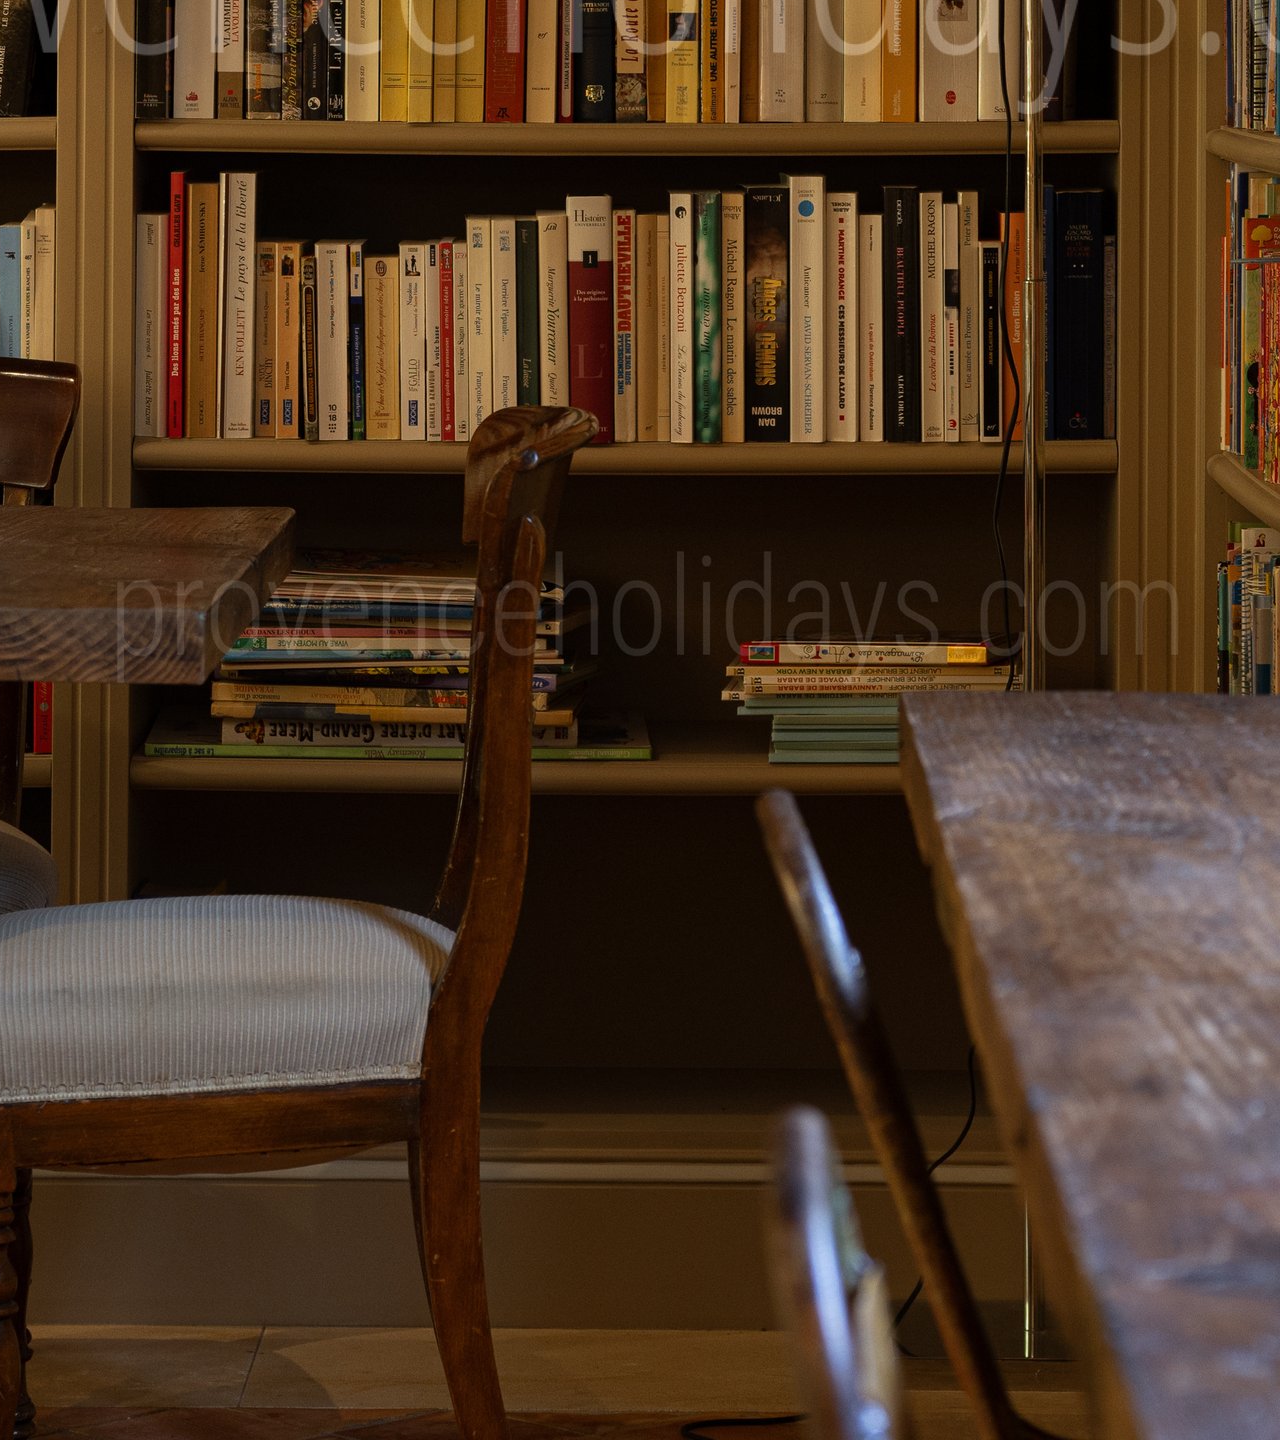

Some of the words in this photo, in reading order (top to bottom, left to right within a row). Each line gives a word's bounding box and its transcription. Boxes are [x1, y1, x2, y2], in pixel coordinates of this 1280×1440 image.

[329, 9, 343, 47] Reine
[621, 8, 639, 42] Route
[621, 48, 638, 62] La
[709, 28, 718, 60] AUTRE
[329, 51, 342, 70] La
[709, 62, 718, 81] UNE
[236, 180, 247, 218] liberté
[236, 223, 247, 234] la
[927, 199, 936, 235] RAGON
[236, 238, 247, 251] de
[726, 239, 737, 273] Michel
[927, 237, 936, 279] MICHEL
[237, 256, 249, 284] pays
[617, 215, 631, 332] DAUTHEVILLE
[674, 242, 687, 283] Juliette
[235, 287, 245, 302] Le
[700, 288, 711, 327] évasion
[726, 278, 736, 312] Ragon
[1012, 291, 1021, 317] Blixen
[676, 287, 687, 333] Benzoni
[236, 308, 245, 353] FOLLETT
[727, 318, 737, 332] Le
[1012, 319, 1021, 343] Karen
[701, 330, 711, 354] Mon
[726, 334, 736, 364] marin
[235, 354, 244, 376] KEN
[726, 367, 737, 384] des
[727, 387, 737, 416] sables
[752, 407, 783, 415] BROWN
[757, 418, 776, 426] DAN
[269, 722, 374, 743] GRAND-MÈRE
[381, 723, 431, 741] D'ÊTRE
